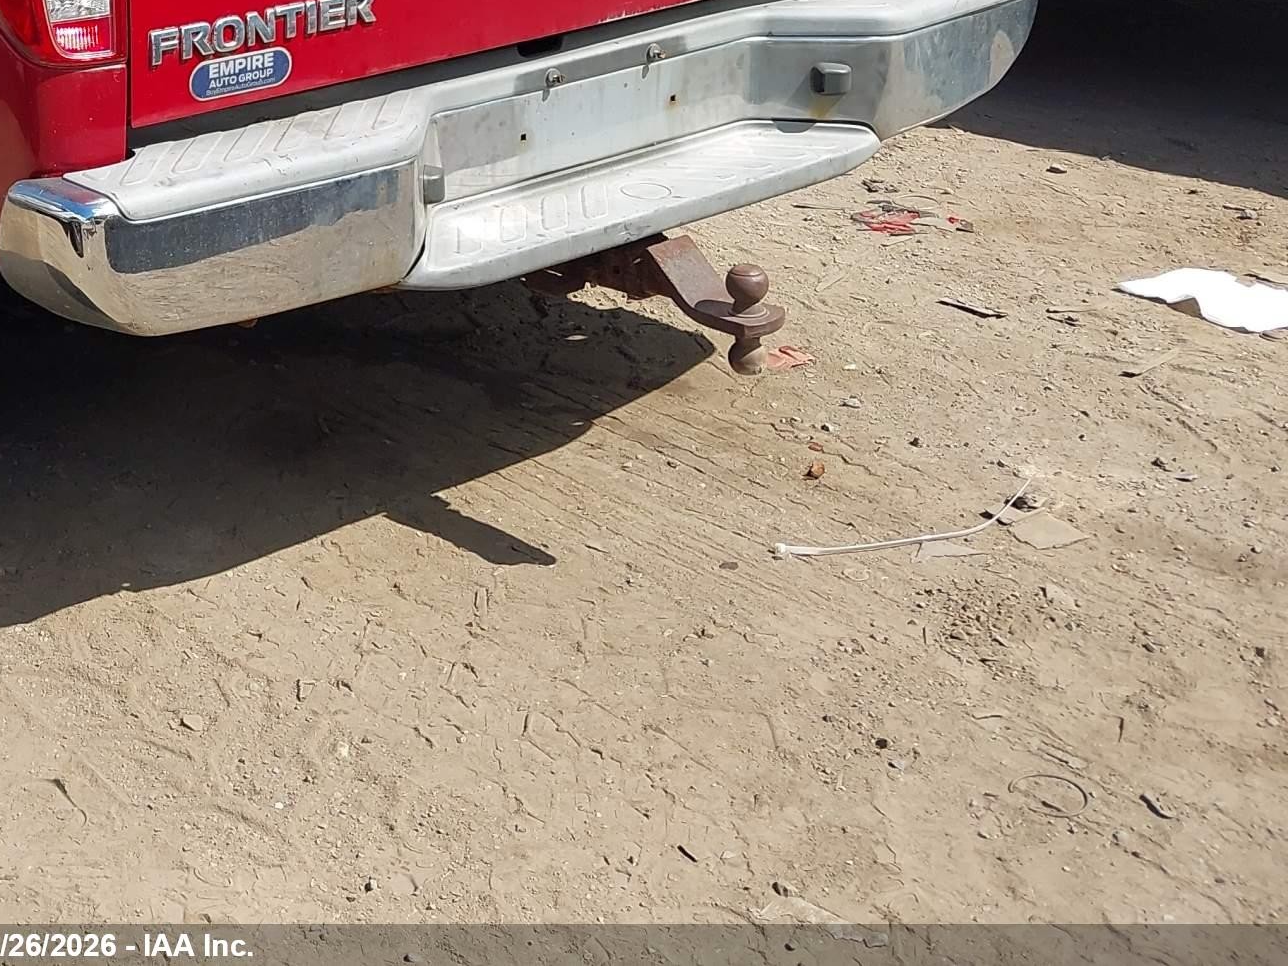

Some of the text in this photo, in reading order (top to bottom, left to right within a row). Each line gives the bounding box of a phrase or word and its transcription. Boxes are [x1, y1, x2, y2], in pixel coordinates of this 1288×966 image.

[208, 52, 275, 79] EMPIRE
[209, 68, 274, 90] AUTO GROUP
